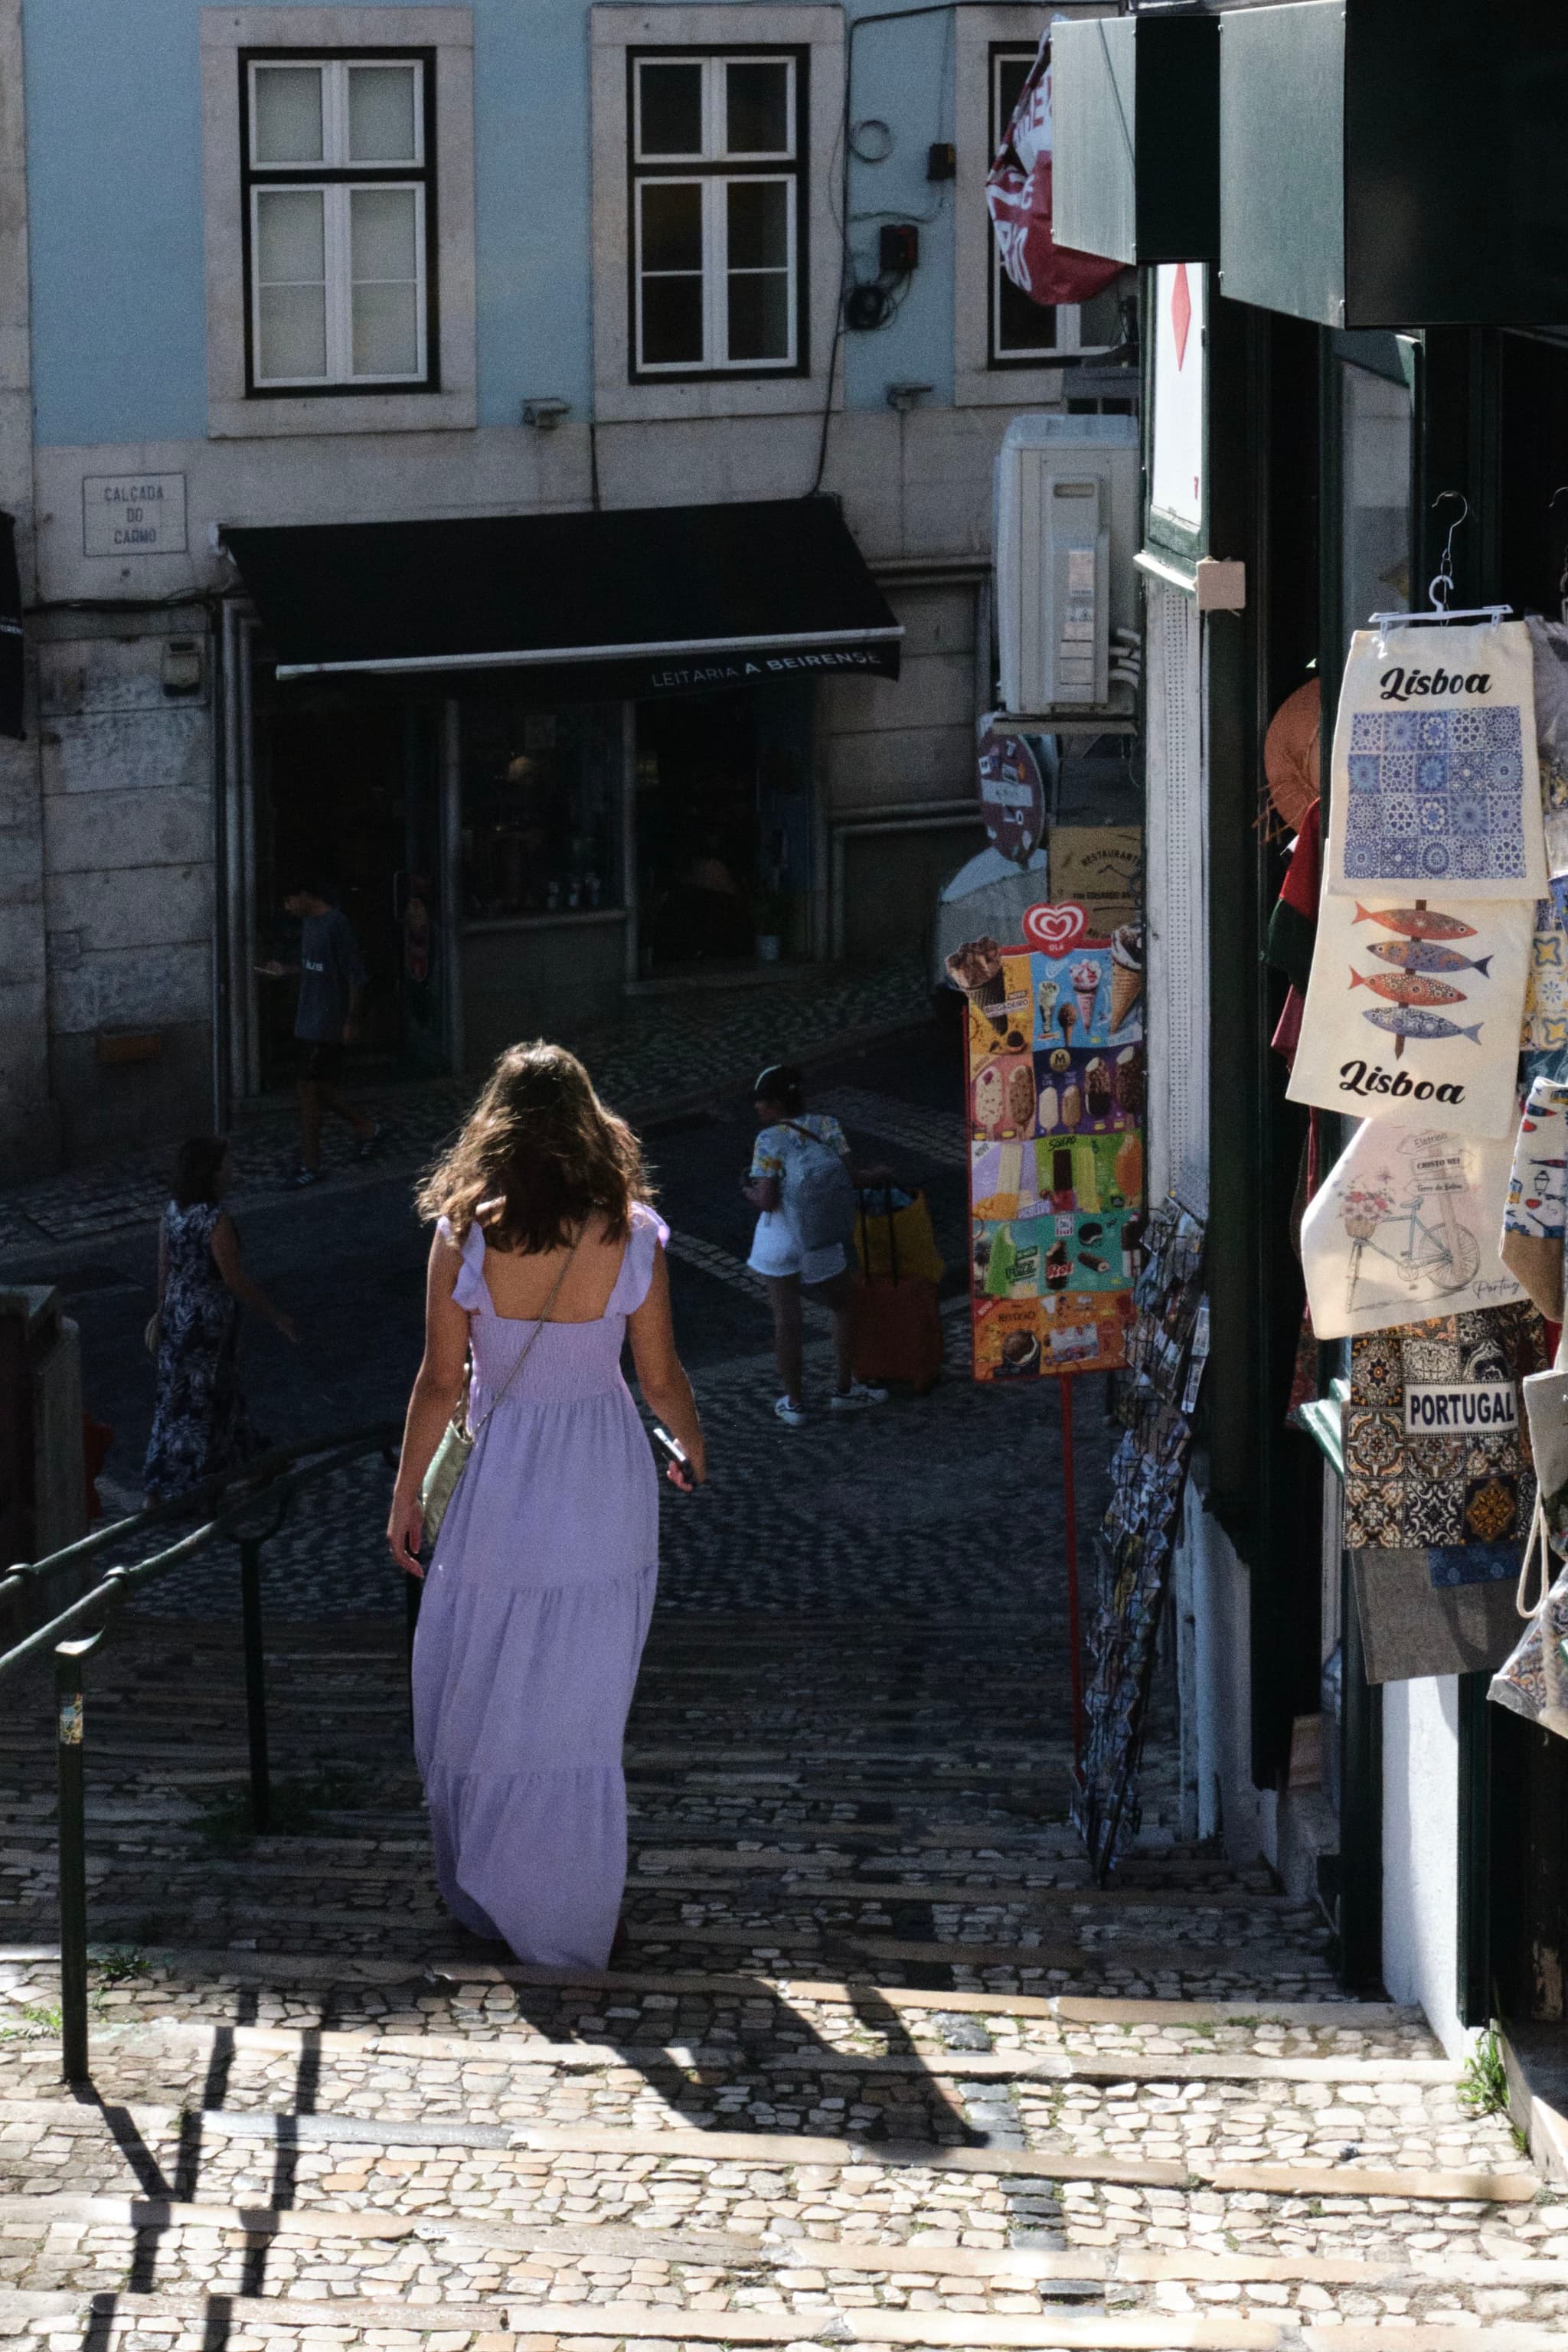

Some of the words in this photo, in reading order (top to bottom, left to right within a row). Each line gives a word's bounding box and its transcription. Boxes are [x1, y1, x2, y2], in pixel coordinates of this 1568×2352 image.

[104, 485, 164, 503] CALÇADA
[126, 508, 143, 523] DO
[113, 528, 157, 544] CARMO
[652, 666, 739, 688] LEITARIA
[744, 662, 762, 675] A
[766, 651, 881, 671] BEIRENSE
[1380, 667, 1492, 701] Lisboa
[985, 998, 1029, 1014] BRIGADEIRO
[1339, 1060, 1465, 1104] Lisboa
[1417, 1159, 1445, 1169] CRISTO
[1410, 1392, 1514, 1426] PORTUGAL
